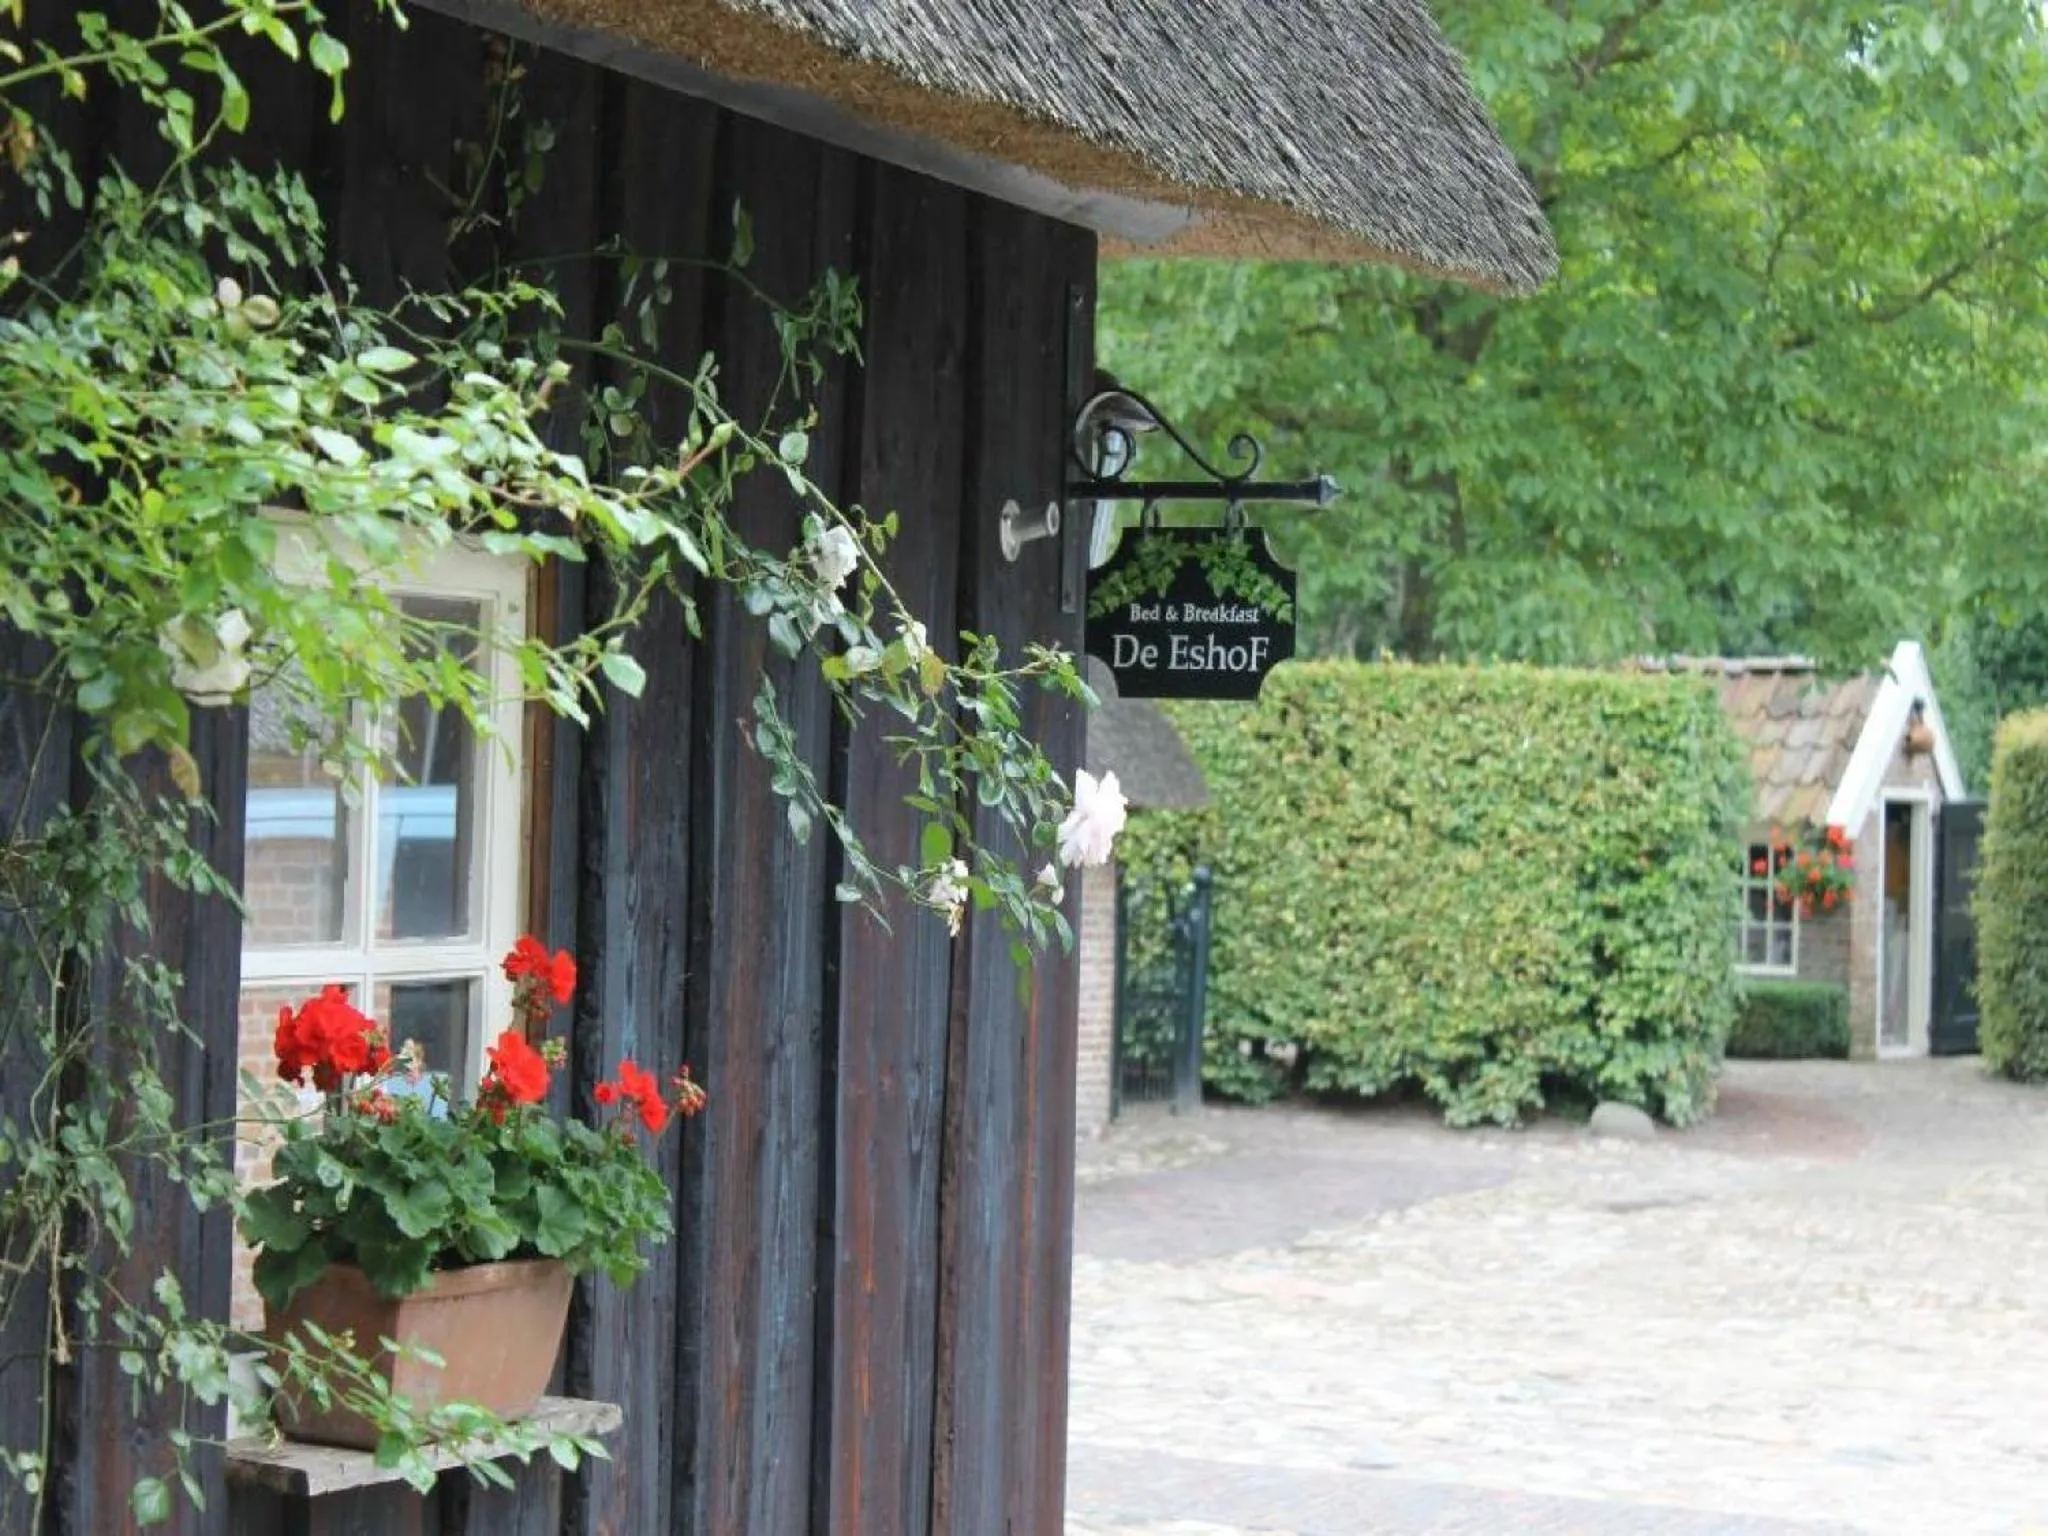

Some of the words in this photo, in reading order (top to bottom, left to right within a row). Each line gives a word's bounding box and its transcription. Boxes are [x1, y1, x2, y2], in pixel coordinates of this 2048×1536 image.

[1130, 603, 1159, 622] Bed
[1165, 604, 1179, 622] &
[1183, 603, 1260, 623] Breakfast
[1112, 634, 1159, 669] De
